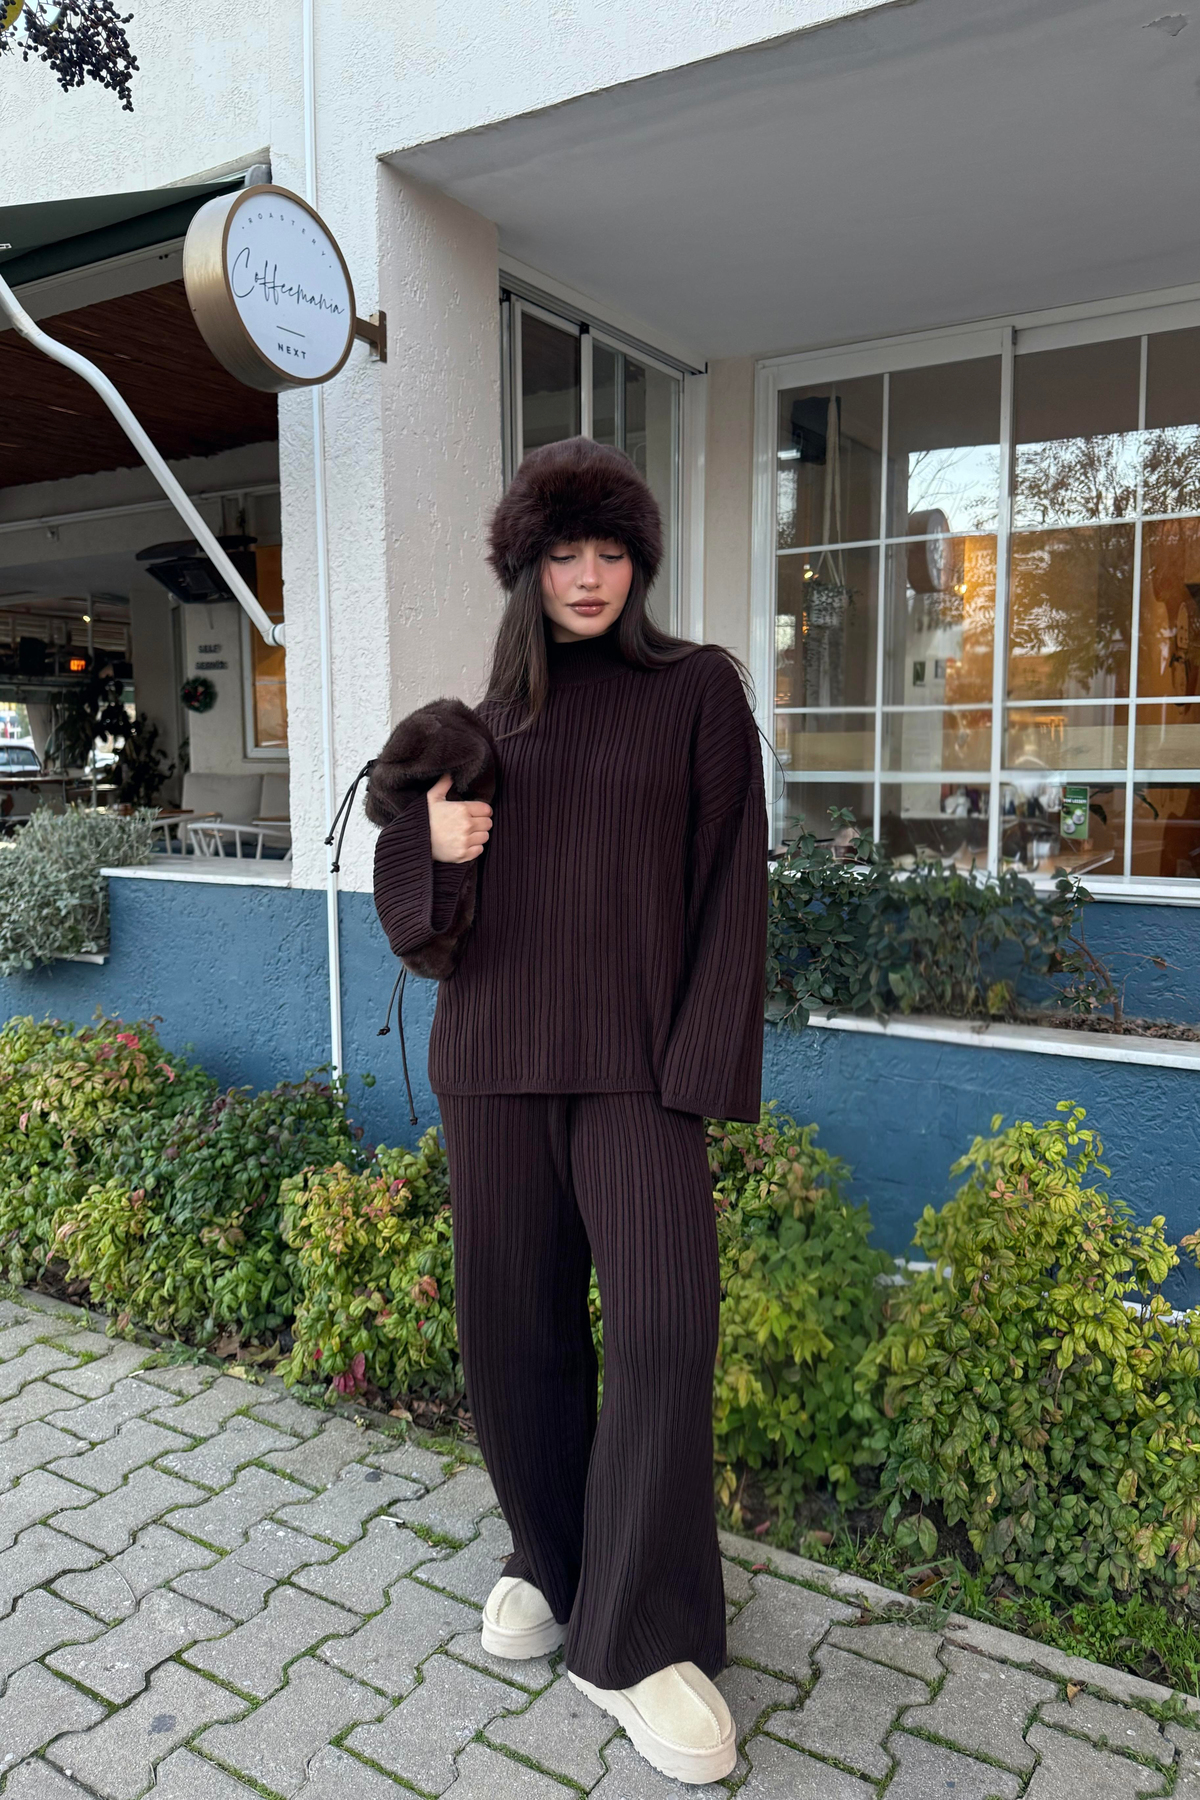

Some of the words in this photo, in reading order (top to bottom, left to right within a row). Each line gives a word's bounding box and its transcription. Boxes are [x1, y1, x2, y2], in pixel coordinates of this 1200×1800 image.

[248, 212, 326, 256] ROASTERY
[231, 247, 345, 314] Coffeemania
[277, 342, 307, 359] NEXT
